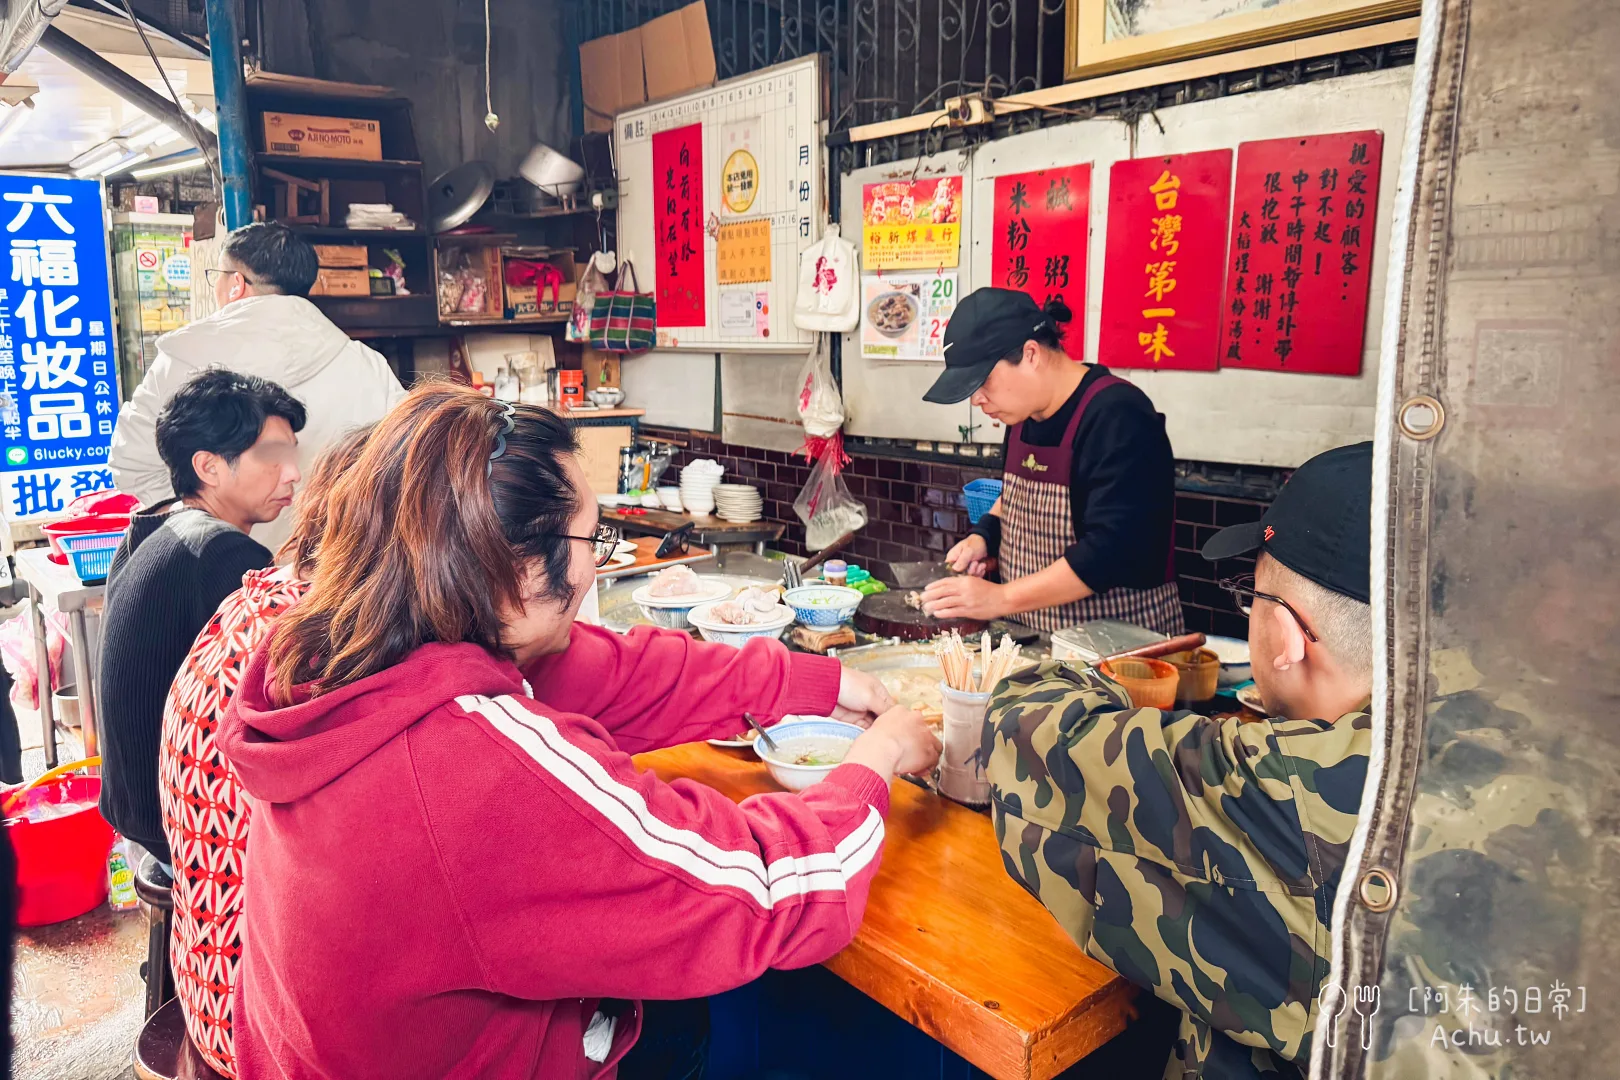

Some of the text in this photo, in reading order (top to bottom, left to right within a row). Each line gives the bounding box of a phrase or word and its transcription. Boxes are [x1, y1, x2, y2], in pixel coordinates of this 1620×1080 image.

[624, 120, 645, 141] 備註
[675, 107, 682, 116] 12
[683, 104, 690, 114] 11
[692, 102, 700, 112] 10
[719, 95, 724, 105] 7
[728, 93, 734, 103] 6
[738, 90, 743, 100] 5
[747, 87, 753, 97] 4
[757, 85, 763, 95] 3
[767, 82, 773, 92] 2
[777, 215, 786, 225] 17
[788, 214, 797, 224] 16
[798, 145, 810, 266] 月份行
[1006, 180, 1031, 288] 米粉湯
[1259, 171, 1284, 245] 很抱歉
[932, 279, 953, 298] 20
[1138, 170, 1183, 363] 台灣第一味
[3, 184, 92, 441] 六福化妝品
[88, 319, 113, 435] 星期日公休日
